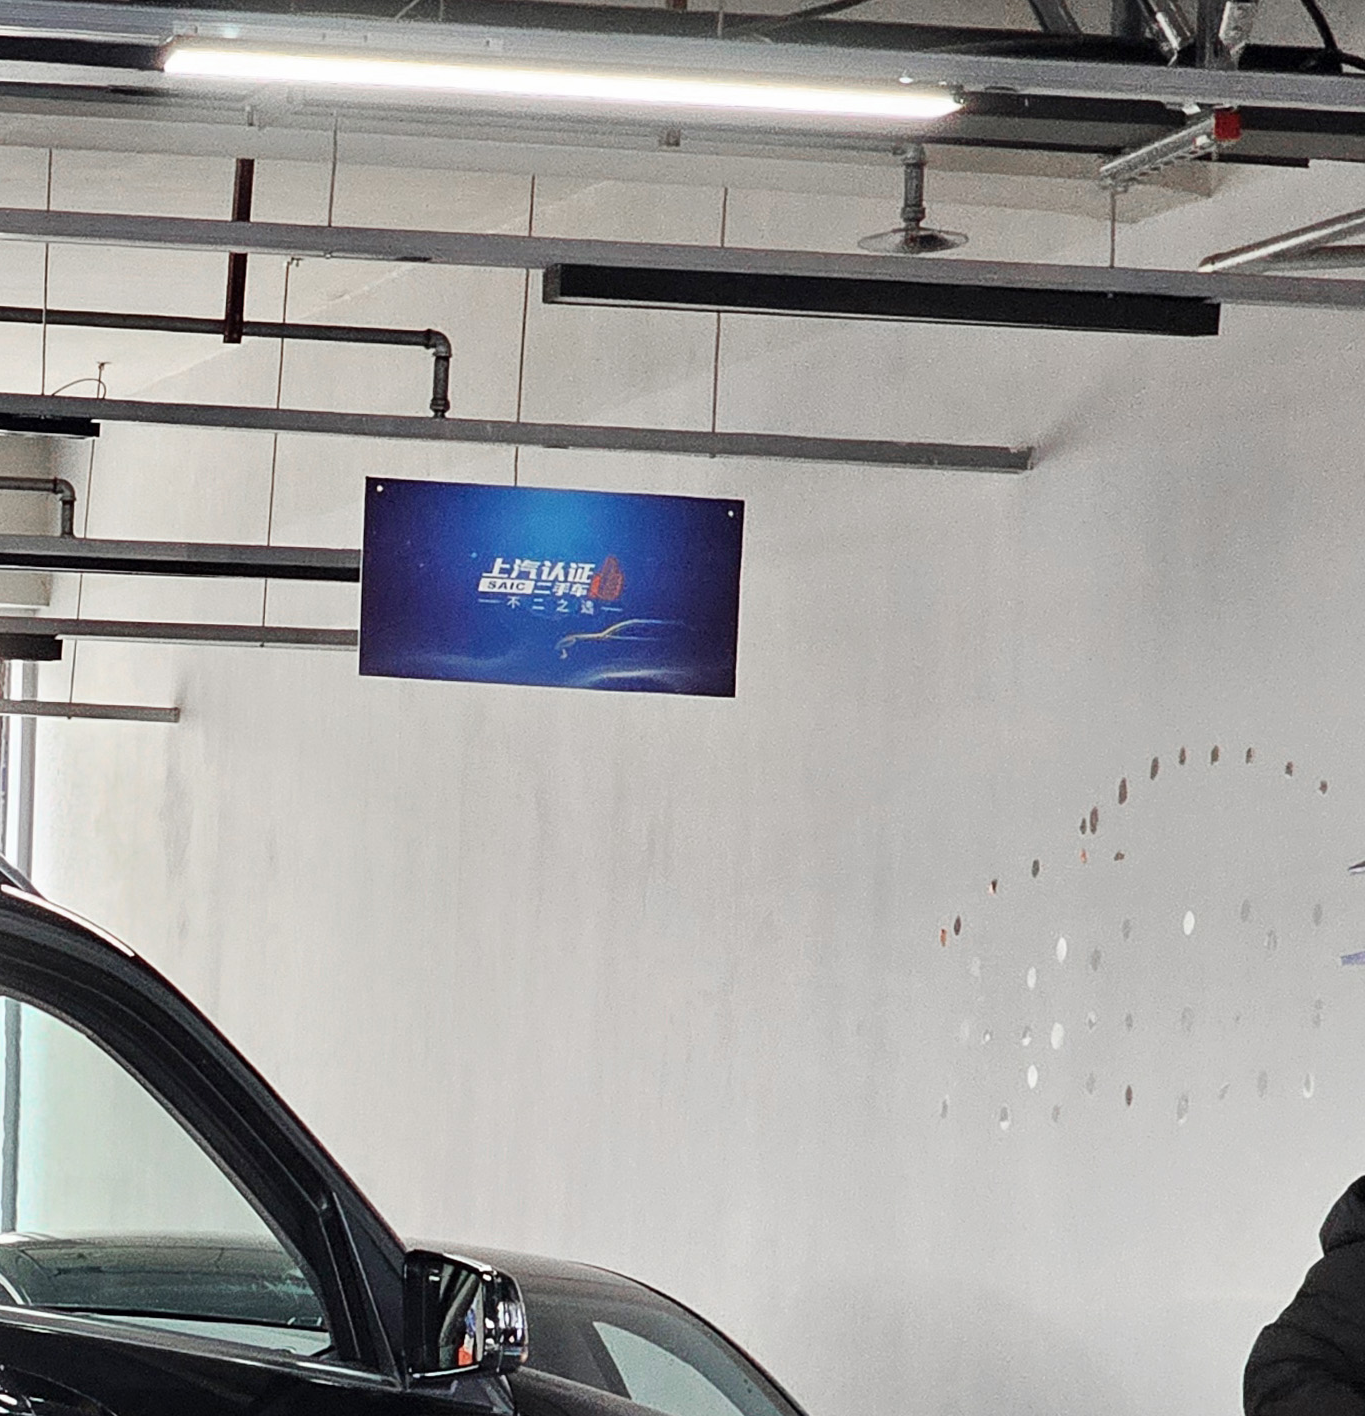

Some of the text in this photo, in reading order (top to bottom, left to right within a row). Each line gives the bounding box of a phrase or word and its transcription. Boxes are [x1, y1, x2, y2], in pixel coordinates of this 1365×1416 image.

[481, 556, 597, 582] 上汽认证
[487, 581, 591, 598] SAIC 二手车
